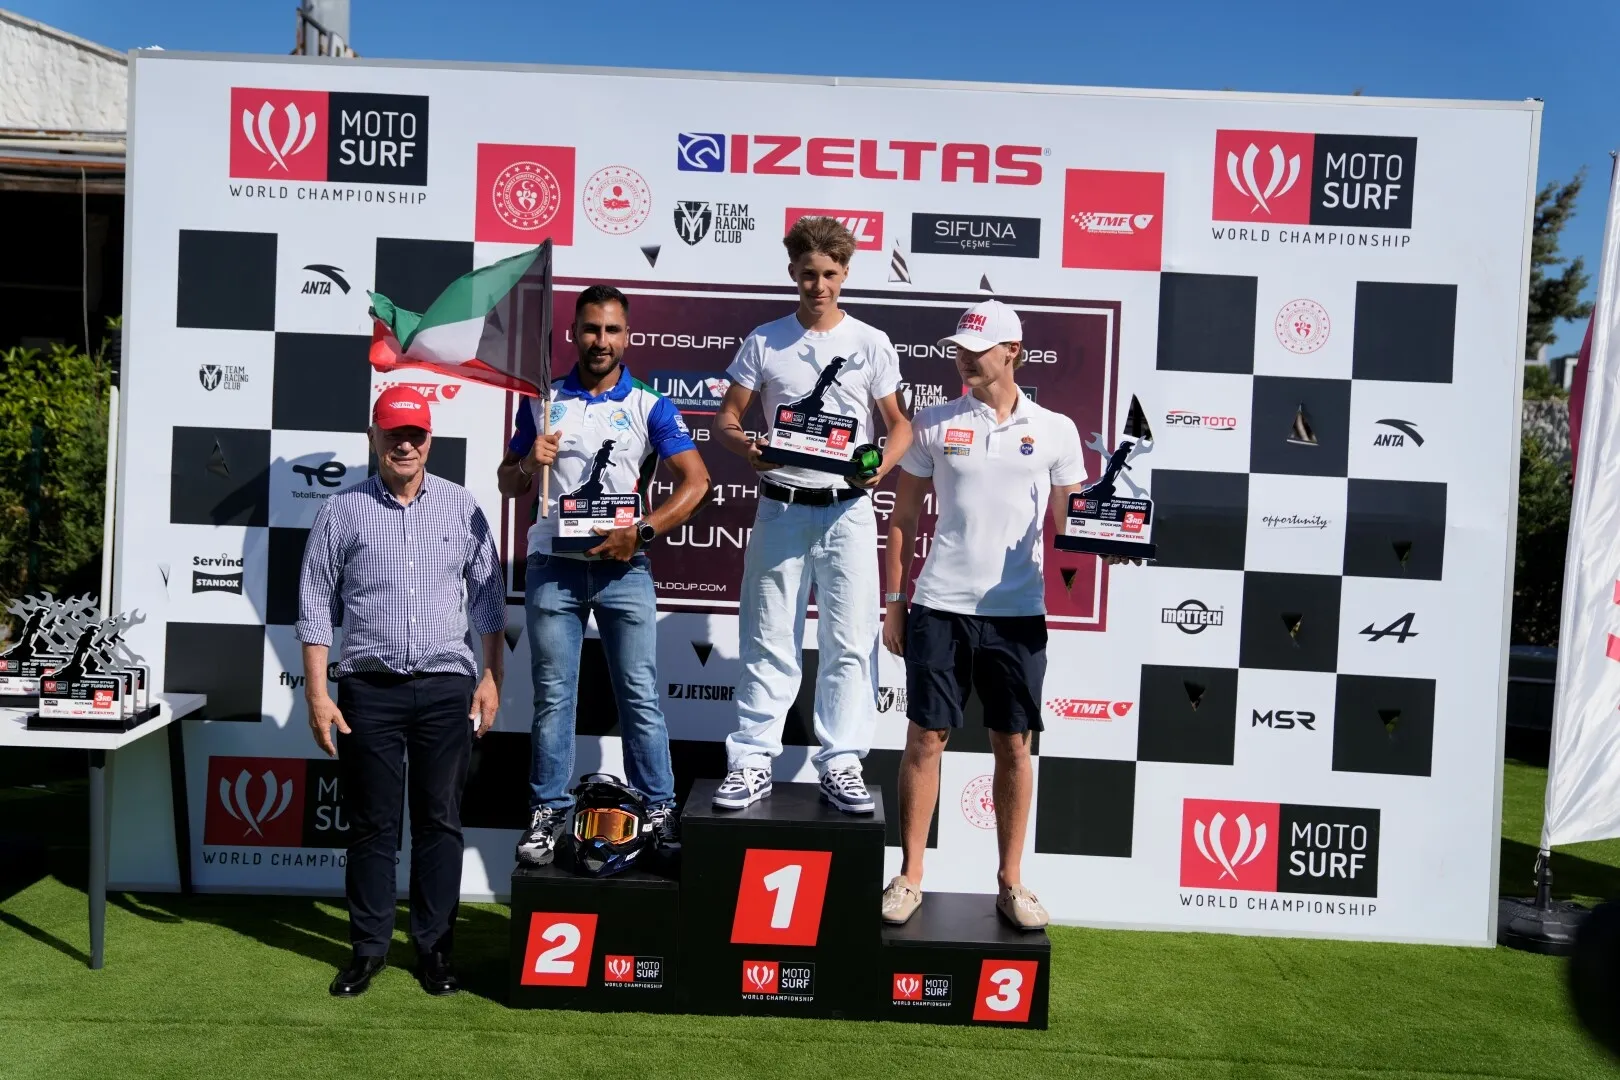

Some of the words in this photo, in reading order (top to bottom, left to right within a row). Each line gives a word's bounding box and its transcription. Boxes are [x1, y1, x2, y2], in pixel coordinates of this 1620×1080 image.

[340, 110, 416, 138] MOTO
[339, 139, 416, 168] SURF
[730, 134, 1042, 186] IZELTAS
[1326, 152, 1402, 181] MOTO
[229, 185, 288, 200] WORLD
[298, 188, 427, 204] CHAMPIONSHIP
[1322, 182, 1401, 210] SURF
[716, 203, 748, 217] TEAM
[715, 217, 755, 231] RACING
[1096, 216, 1128, 226] TMF
[714, 230, 742, 244] CLUB
[935, 220, 1016, 240] SIFUNA
[960, 238, 990, 250] ÇEŞME
[1212, 228, 1270, 242] WORLD
[1279, 230, 1410, 248] CHAMPIONSHIP
[301, 281, 332, 295] ANTA
[628, 332, 735, 350] OTOSURF
[225, 366, 245, 374] TEAM
[224, 374, 249, 382] RACING
[224, 382, 241, 390] CLUB
[915, 384, 942, 396] TEAM
[914, 395, 948, 406] RACING
[1374, 434, 1404, 447] ANTA
[1262, 515, 1328, 530] opportunity
[193, 553, 244, 568] Servind
[196, 578, 239, 588] STANDOX
[1162, 608, 1223, 626] MATTECH
[684, 684, 736, 700] JETSURF
[1072, 702, 1107, 714] TMF
[1252, 708, 1316, 730] MSR
[314, 805, 350, 830] SU
[1291, 822, 1367, 850] MOTO
[202, 851, 262, 865] WORLD
[1288, 850, 1366, 878] SURF
[764, 864, 802, 928] 1
[1180, 894, 1238, 908] WORLD
[1247, 898, 1378, 916] CHAMPIONSHIP
[534, 922, 581, 974] 2
[636, 961, 660, 970] MOTO
[636, 970, 660, 978] SURF
[782, 968, 811, 979] MOTO
[781, 978, 810, 989] SURF
[926, 980, 949, 988] MOTO
[985, 968, 1023, 1012] 3
[925, 988, 948, 996] SURF
